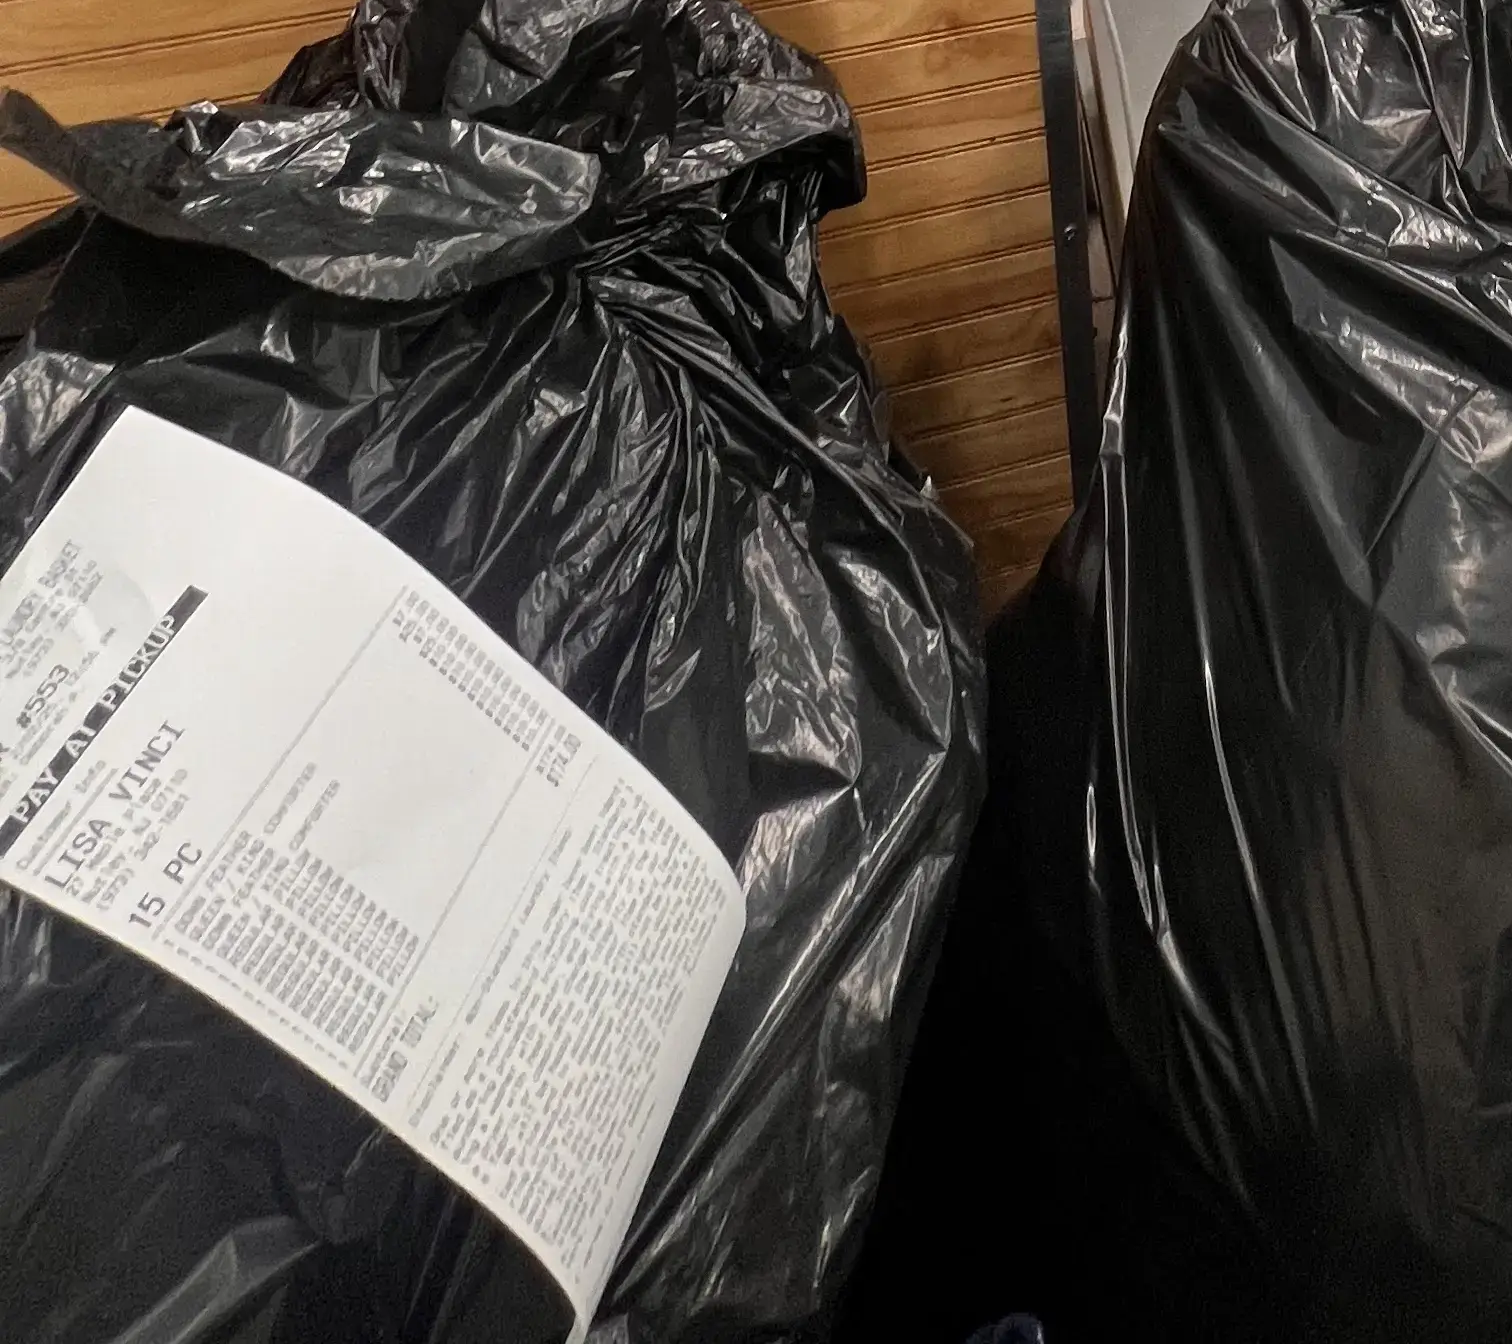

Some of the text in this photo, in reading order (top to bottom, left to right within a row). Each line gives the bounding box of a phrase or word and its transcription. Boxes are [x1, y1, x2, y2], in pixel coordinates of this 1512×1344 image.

[10, 612, 181, 825] PAY AT PICKUP
[14, 661, 70, 730] #553
[43, 715, 186, 892] LISA VINCI
[126, 838, 204, 934] 15 PC
